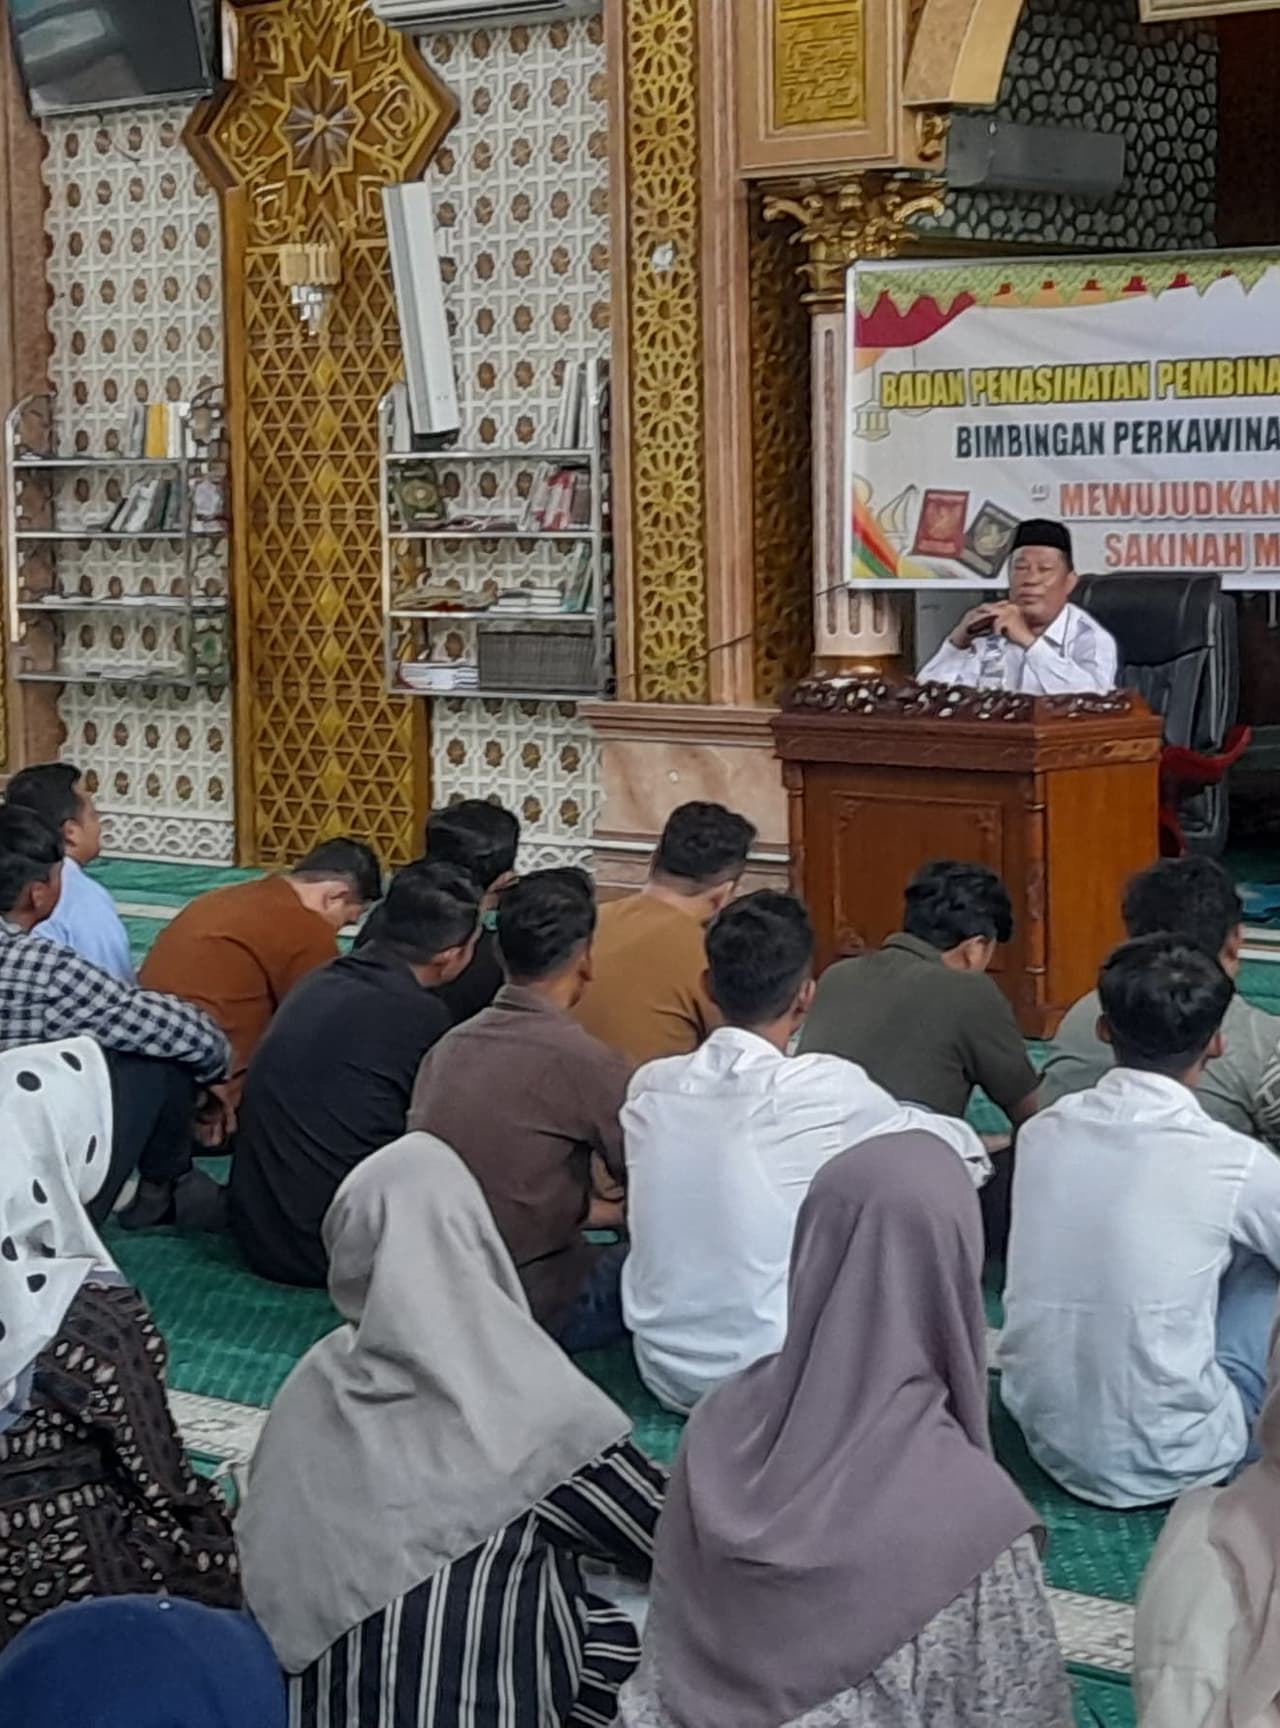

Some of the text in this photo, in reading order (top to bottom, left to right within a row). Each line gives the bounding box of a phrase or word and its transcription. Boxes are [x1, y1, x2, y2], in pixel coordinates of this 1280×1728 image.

[880, 369, 966, 408] BADAN
[971, 362, 1150, 404] PENASIHATAN
[956, 421, 1105, 458] BIMBINGAN
[1104, 532, 1244, 568] SAKINAH
